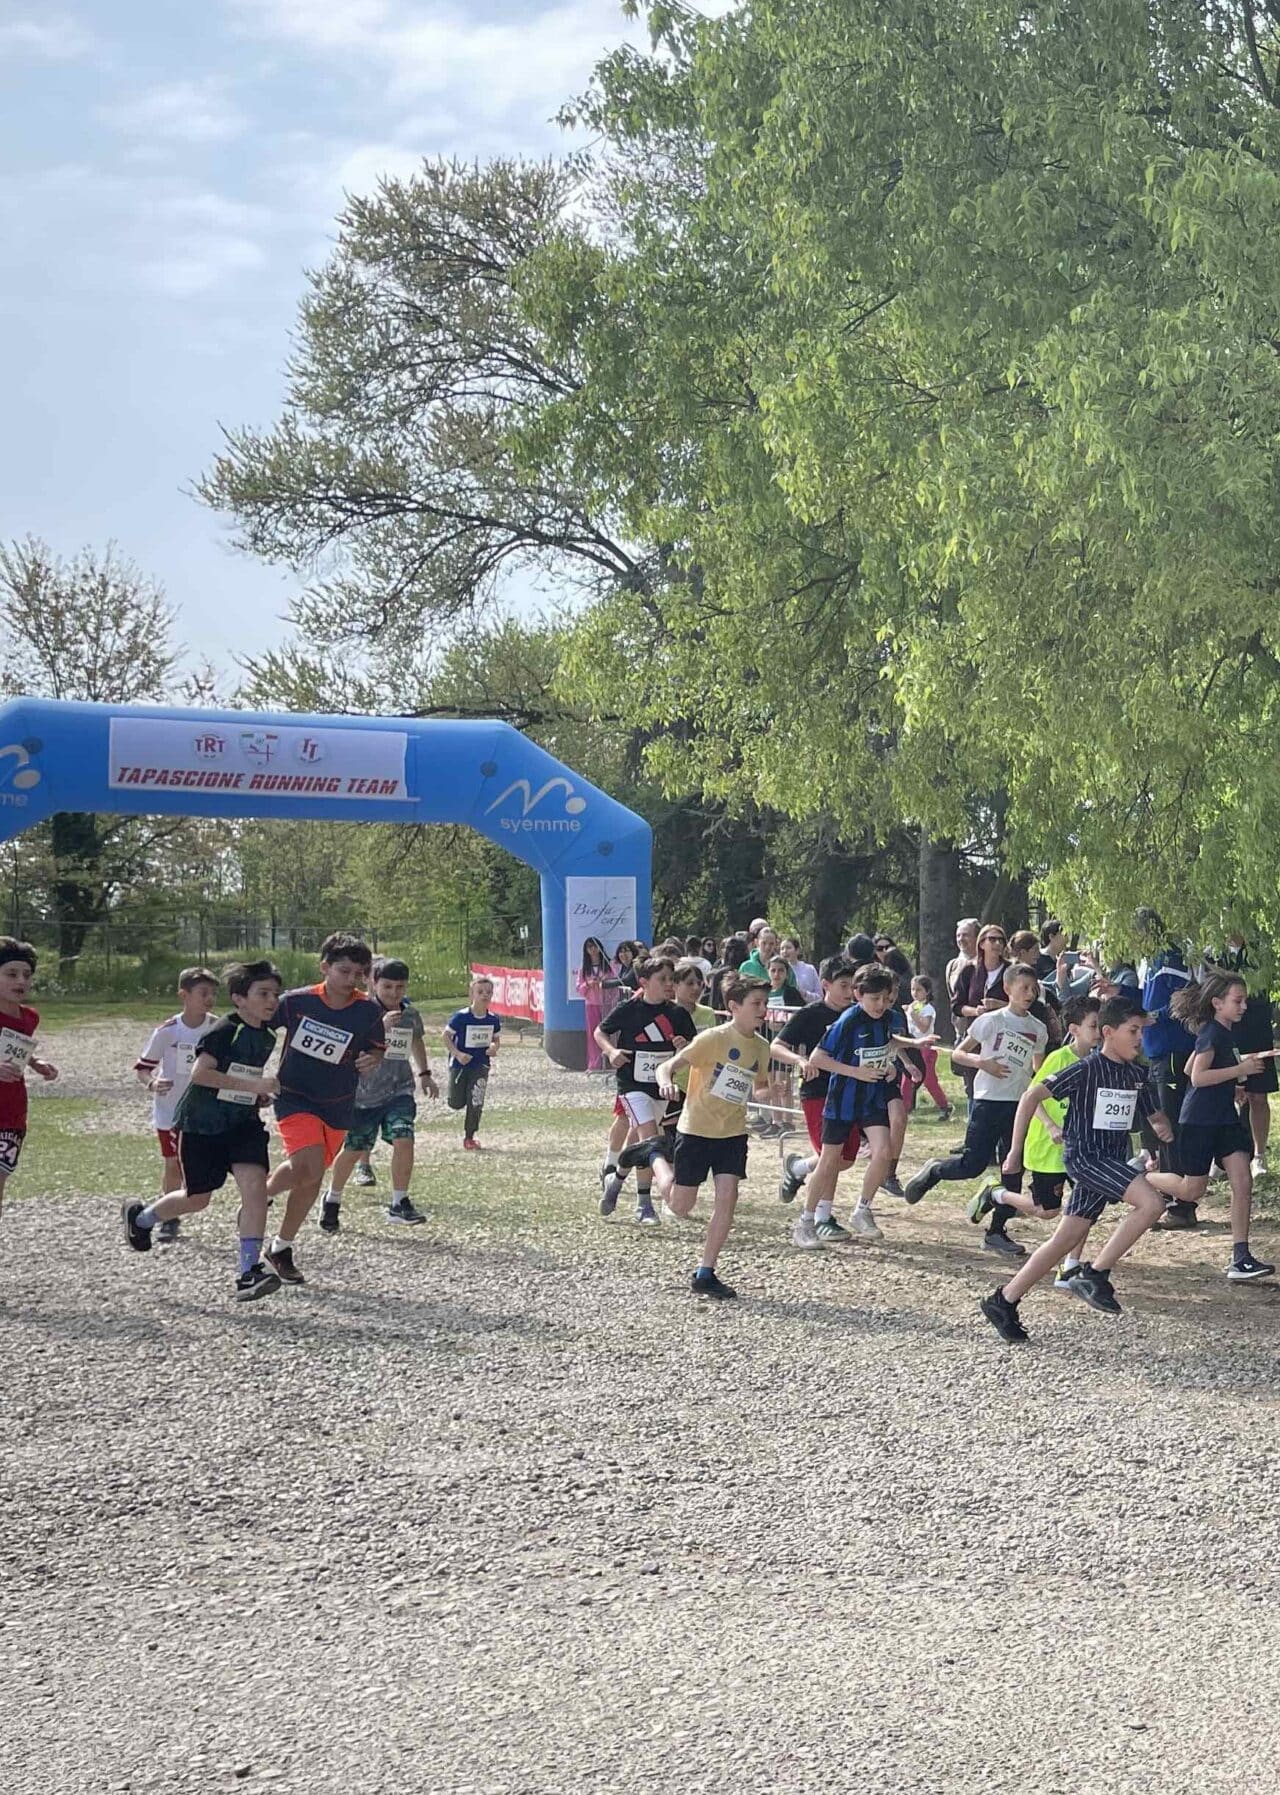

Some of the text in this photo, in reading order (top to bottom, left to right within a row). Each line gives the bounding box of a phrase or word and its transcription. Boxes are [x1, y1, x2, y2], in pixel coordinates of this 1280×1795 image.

[194, 736, 226, 753] TRT
[116, 766, 399, 795] TAPASCIONE RUNNING TEAM
[500, 817, 582, 833] syemme
[301, 1034, 336, 1057] 876
[1105, 1103, 1132, 1116] 2913
